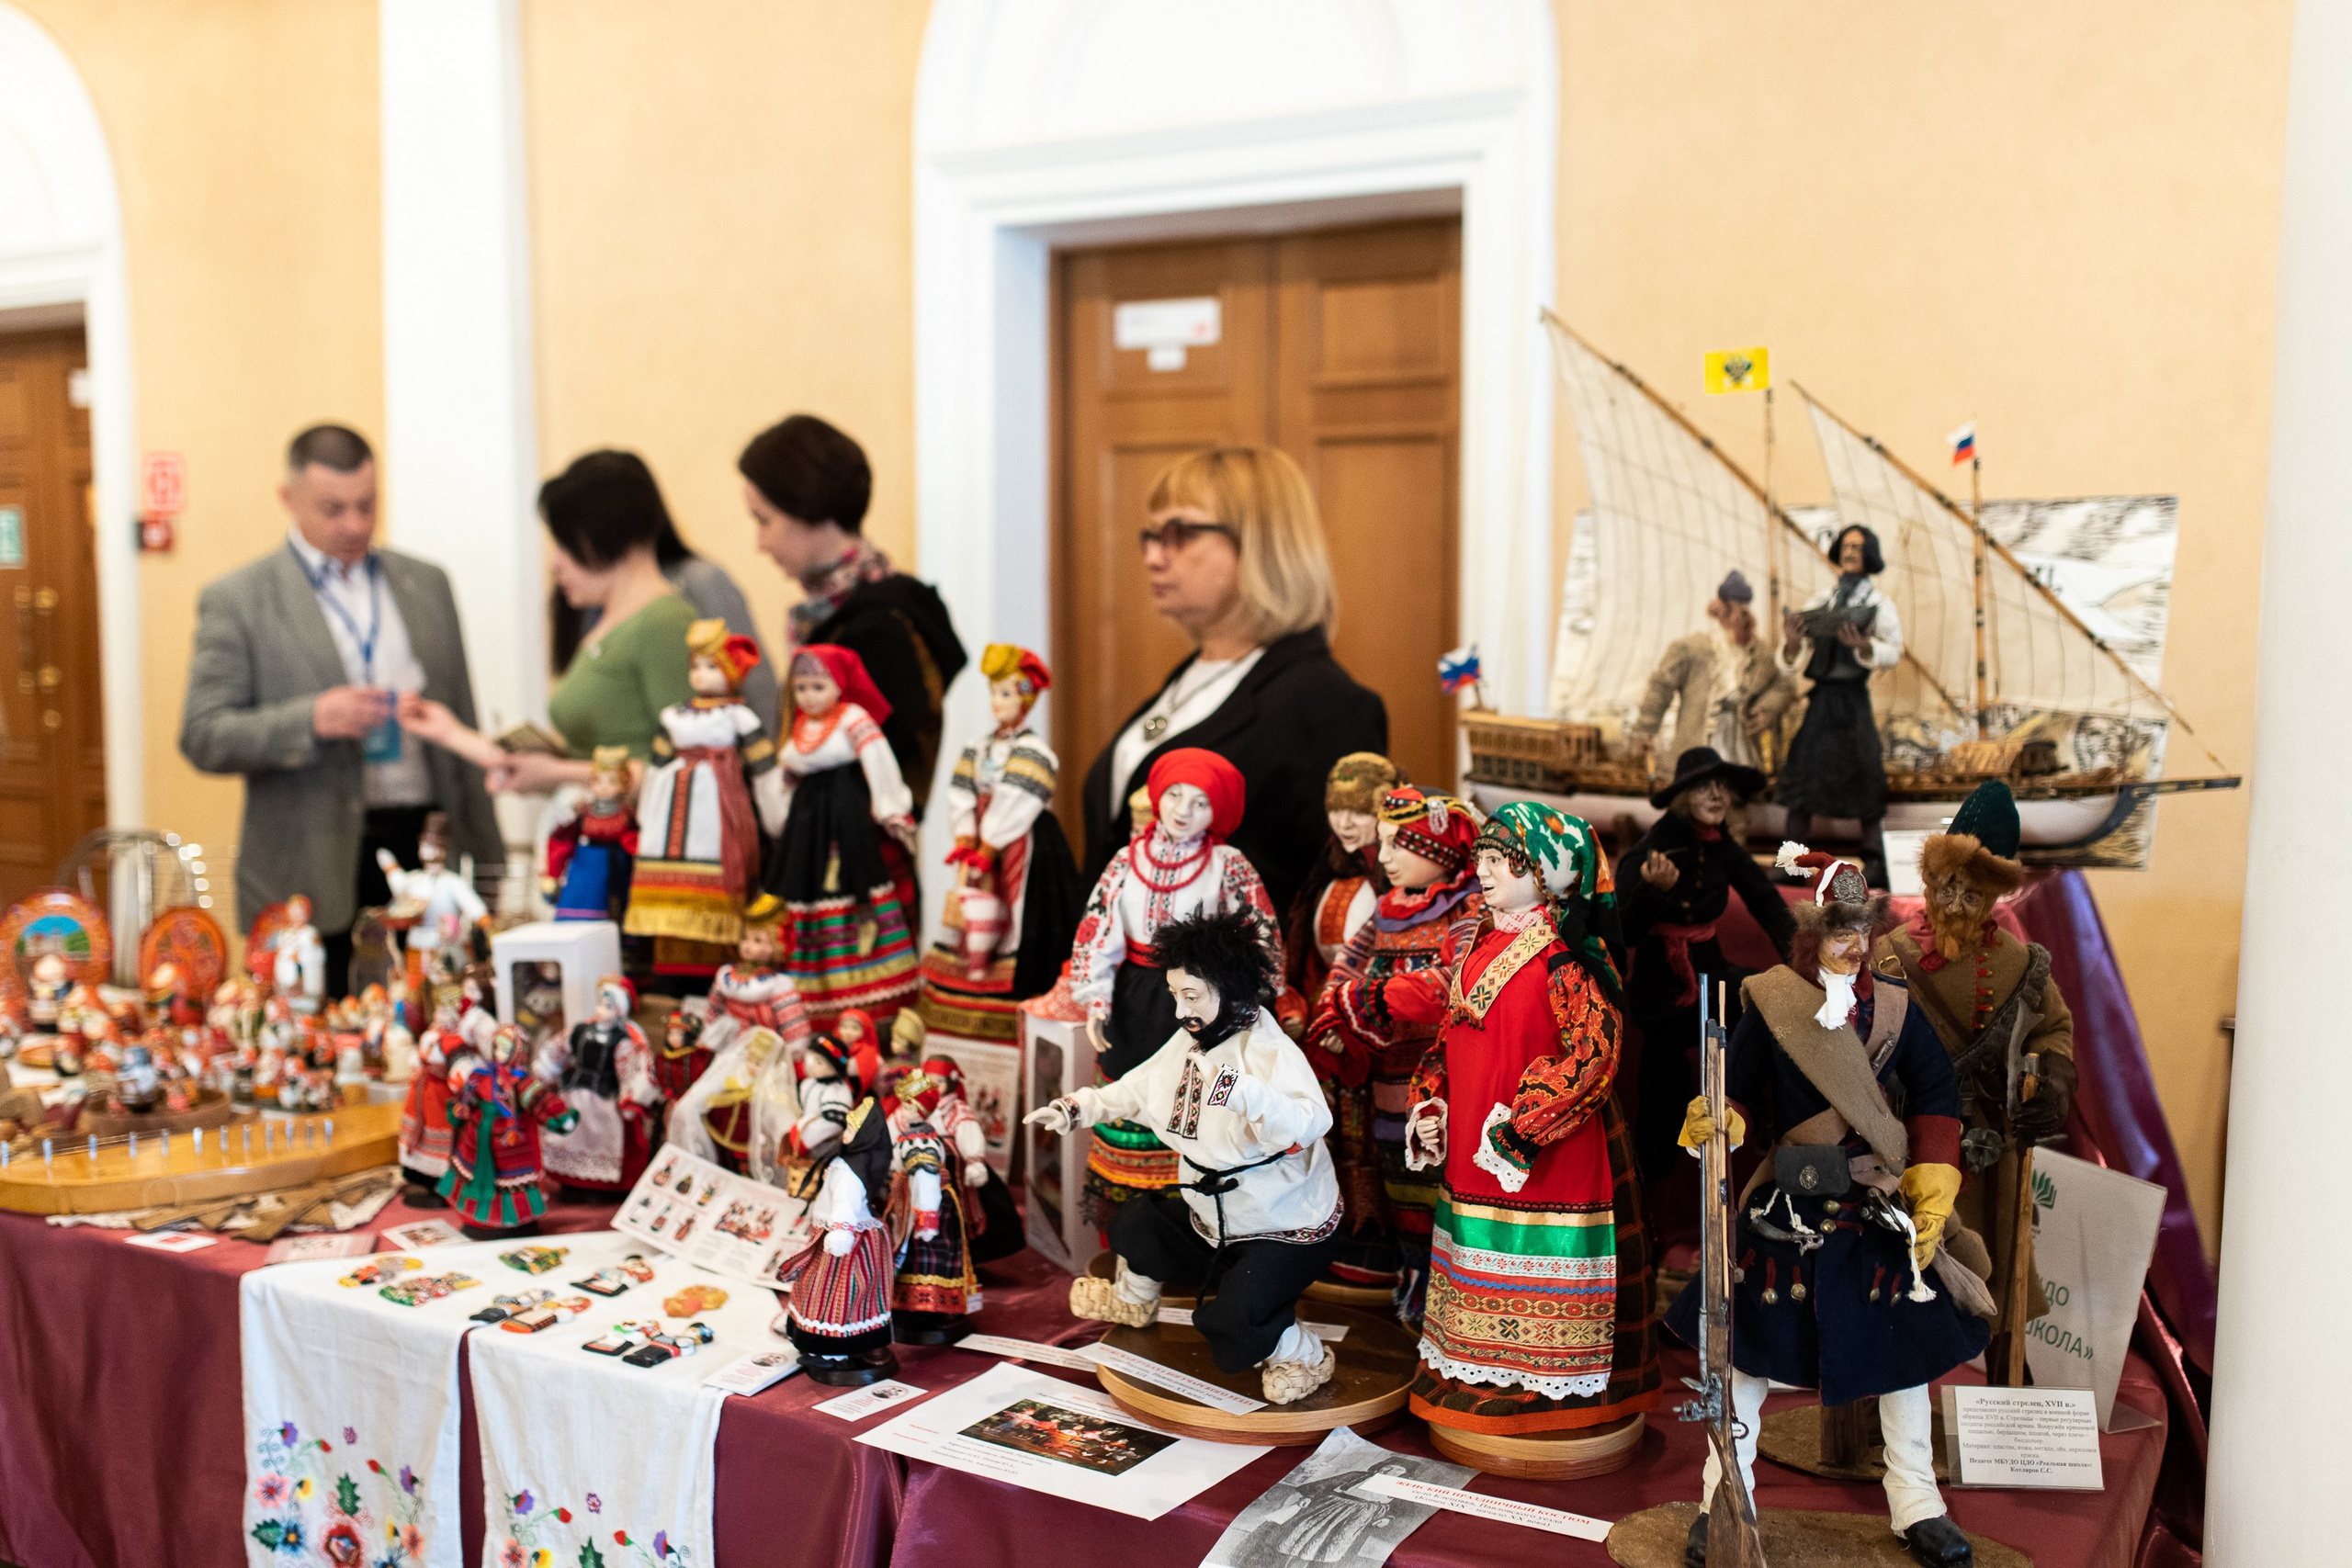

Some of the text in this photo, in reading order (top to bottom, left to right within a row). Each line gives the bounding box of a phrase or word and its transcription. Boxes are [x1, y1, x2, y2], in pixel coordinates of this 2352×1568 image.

[1976, 1398, 2010, 1406] «Русский
[1396, 1480, 1450, 1495] ЖЕНСКИЙ
[1538, 1509, 1590, 1525] КОСТЮМ
